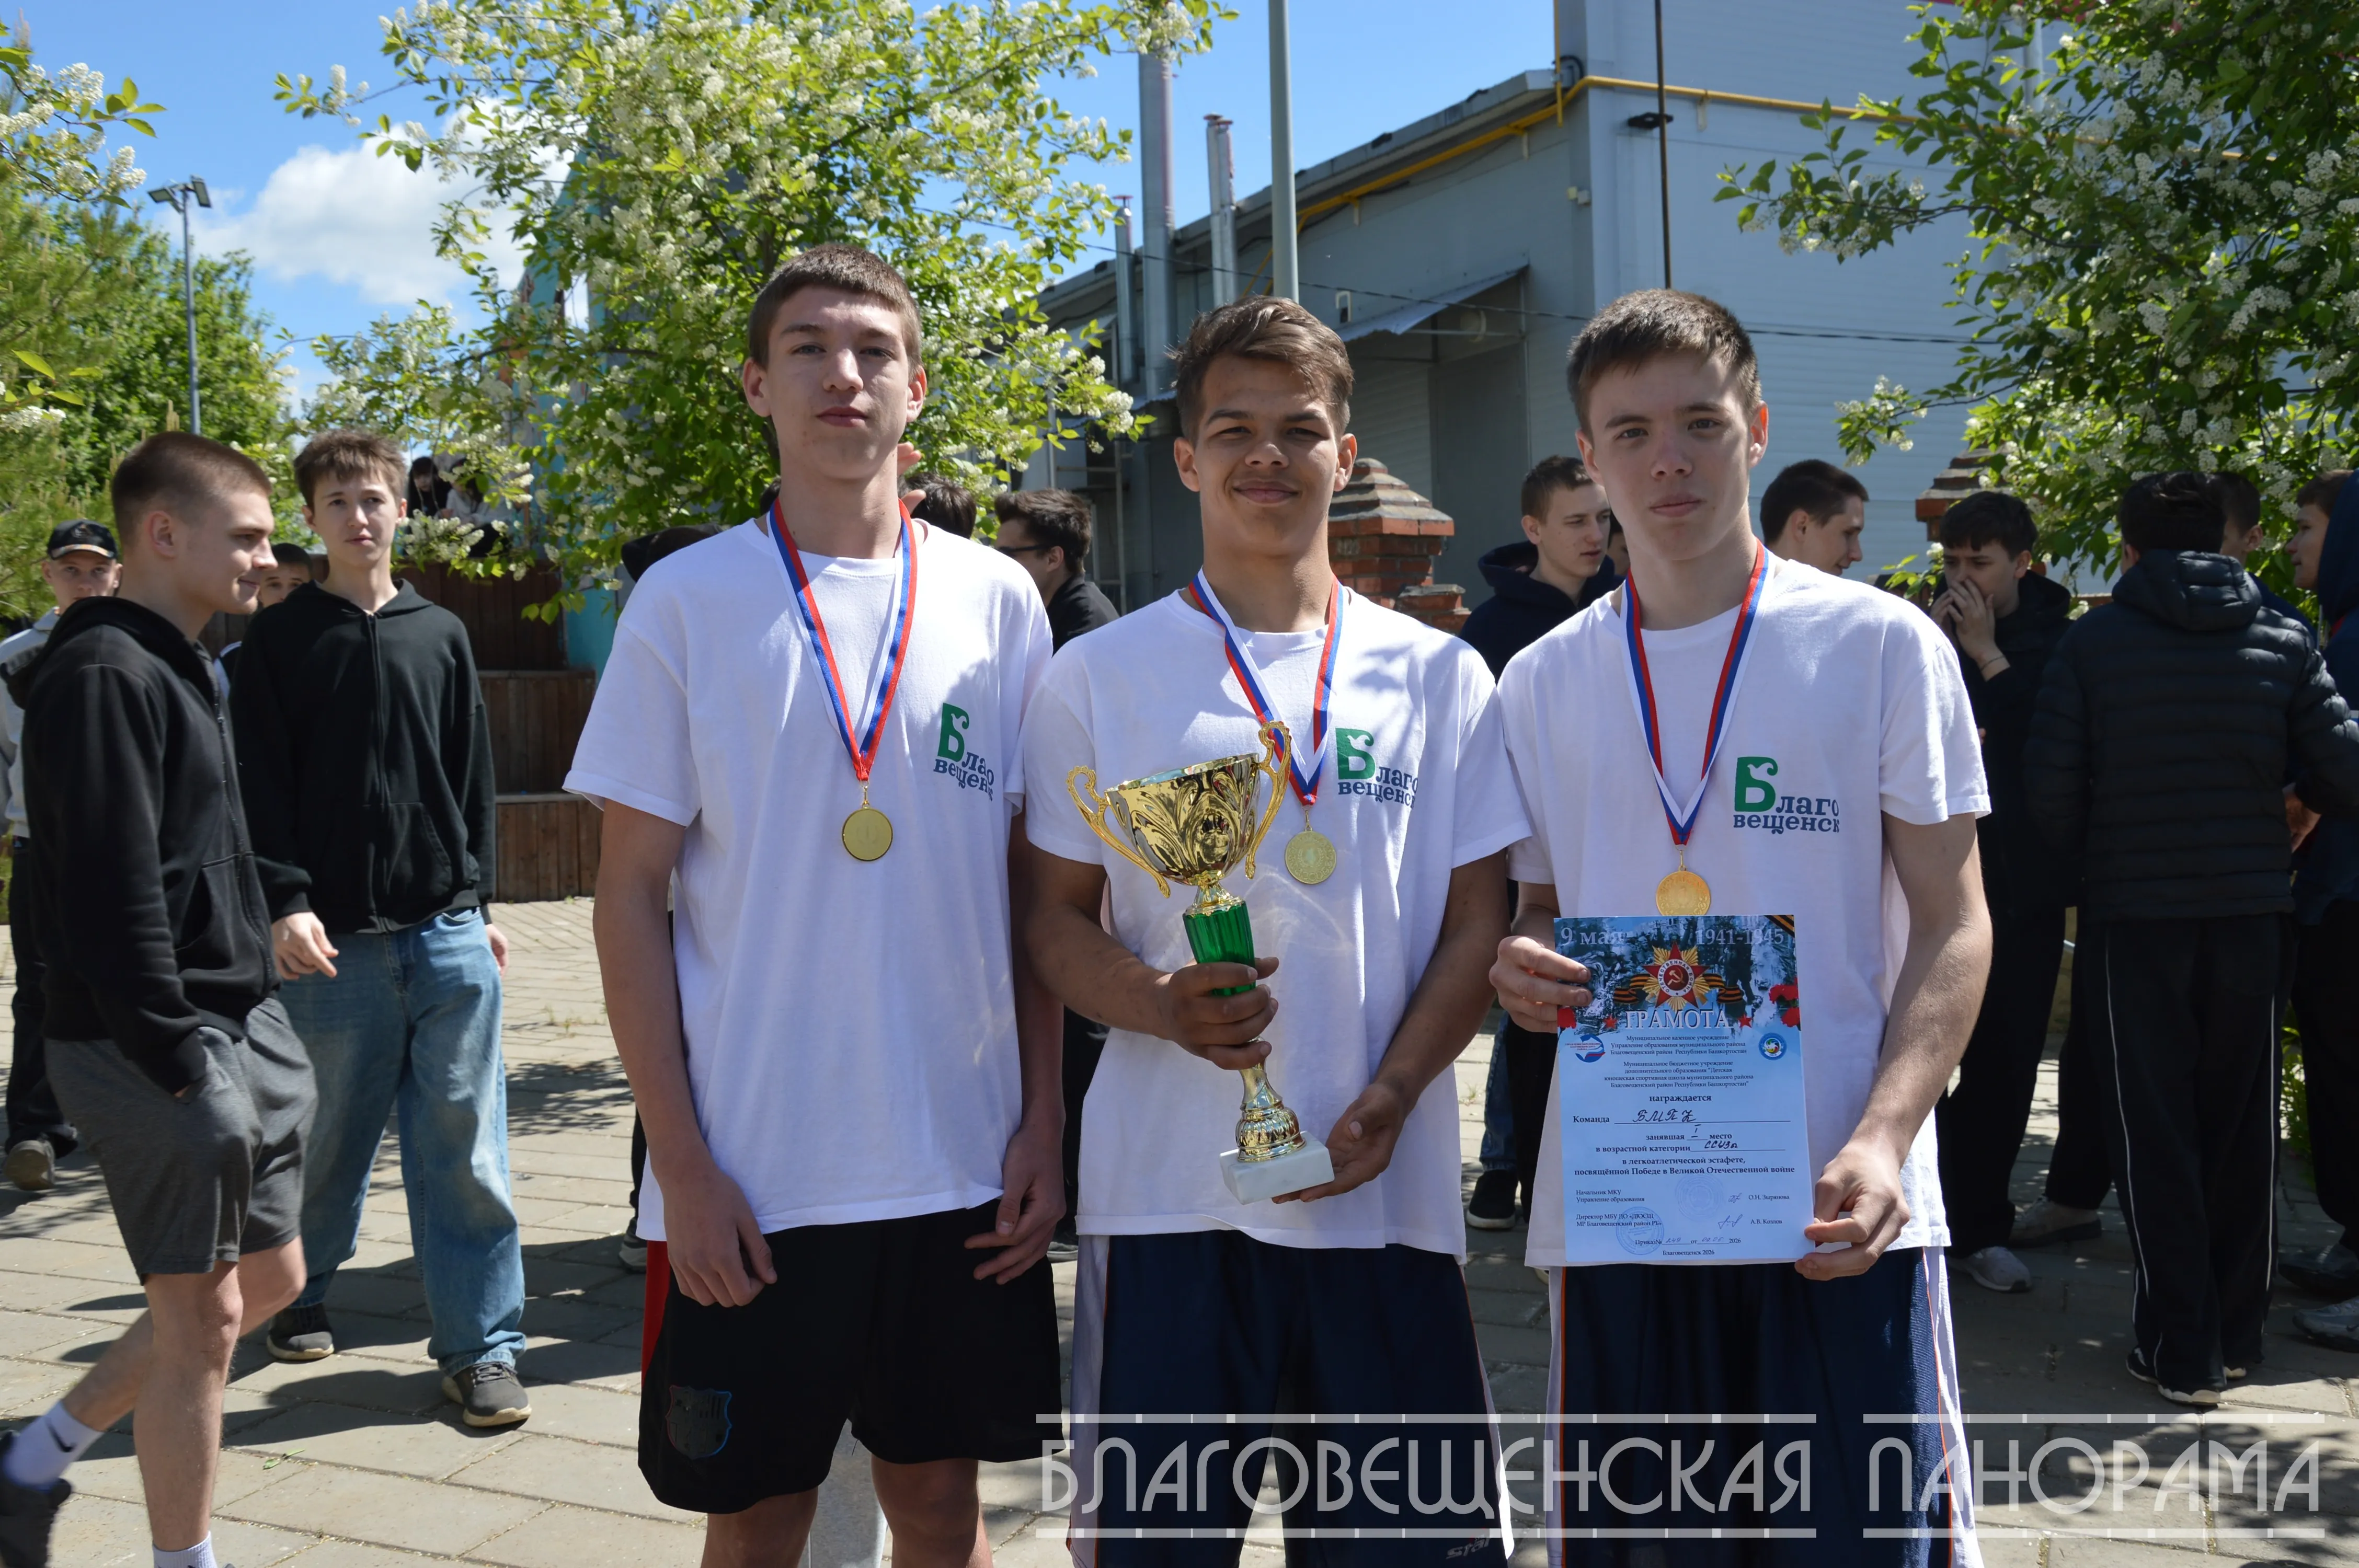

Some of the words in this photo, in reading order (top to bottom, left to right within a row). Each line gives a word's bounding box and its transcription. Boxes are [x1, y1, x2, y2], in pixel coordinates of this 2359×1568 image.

[937, 702, 994, 786] Блао
[933, 759, 993, 802] вещенк
[1734, 756, 1839, 816] Благо
[1733, 814, 1839, 834] вещенск
[1561, 927, 1573, 946] 9
[1579, 931, 1624, 945] мая
[1696, 928, 1784, 946] 1941-1945
[1659, 960, 1690, 993] ОТЕЧЕСТВЕННАЯ
[1624, 1009, 1734, 1029] ГРАМОТА
[1708, 1157, 1745, 1165] эстафете,
